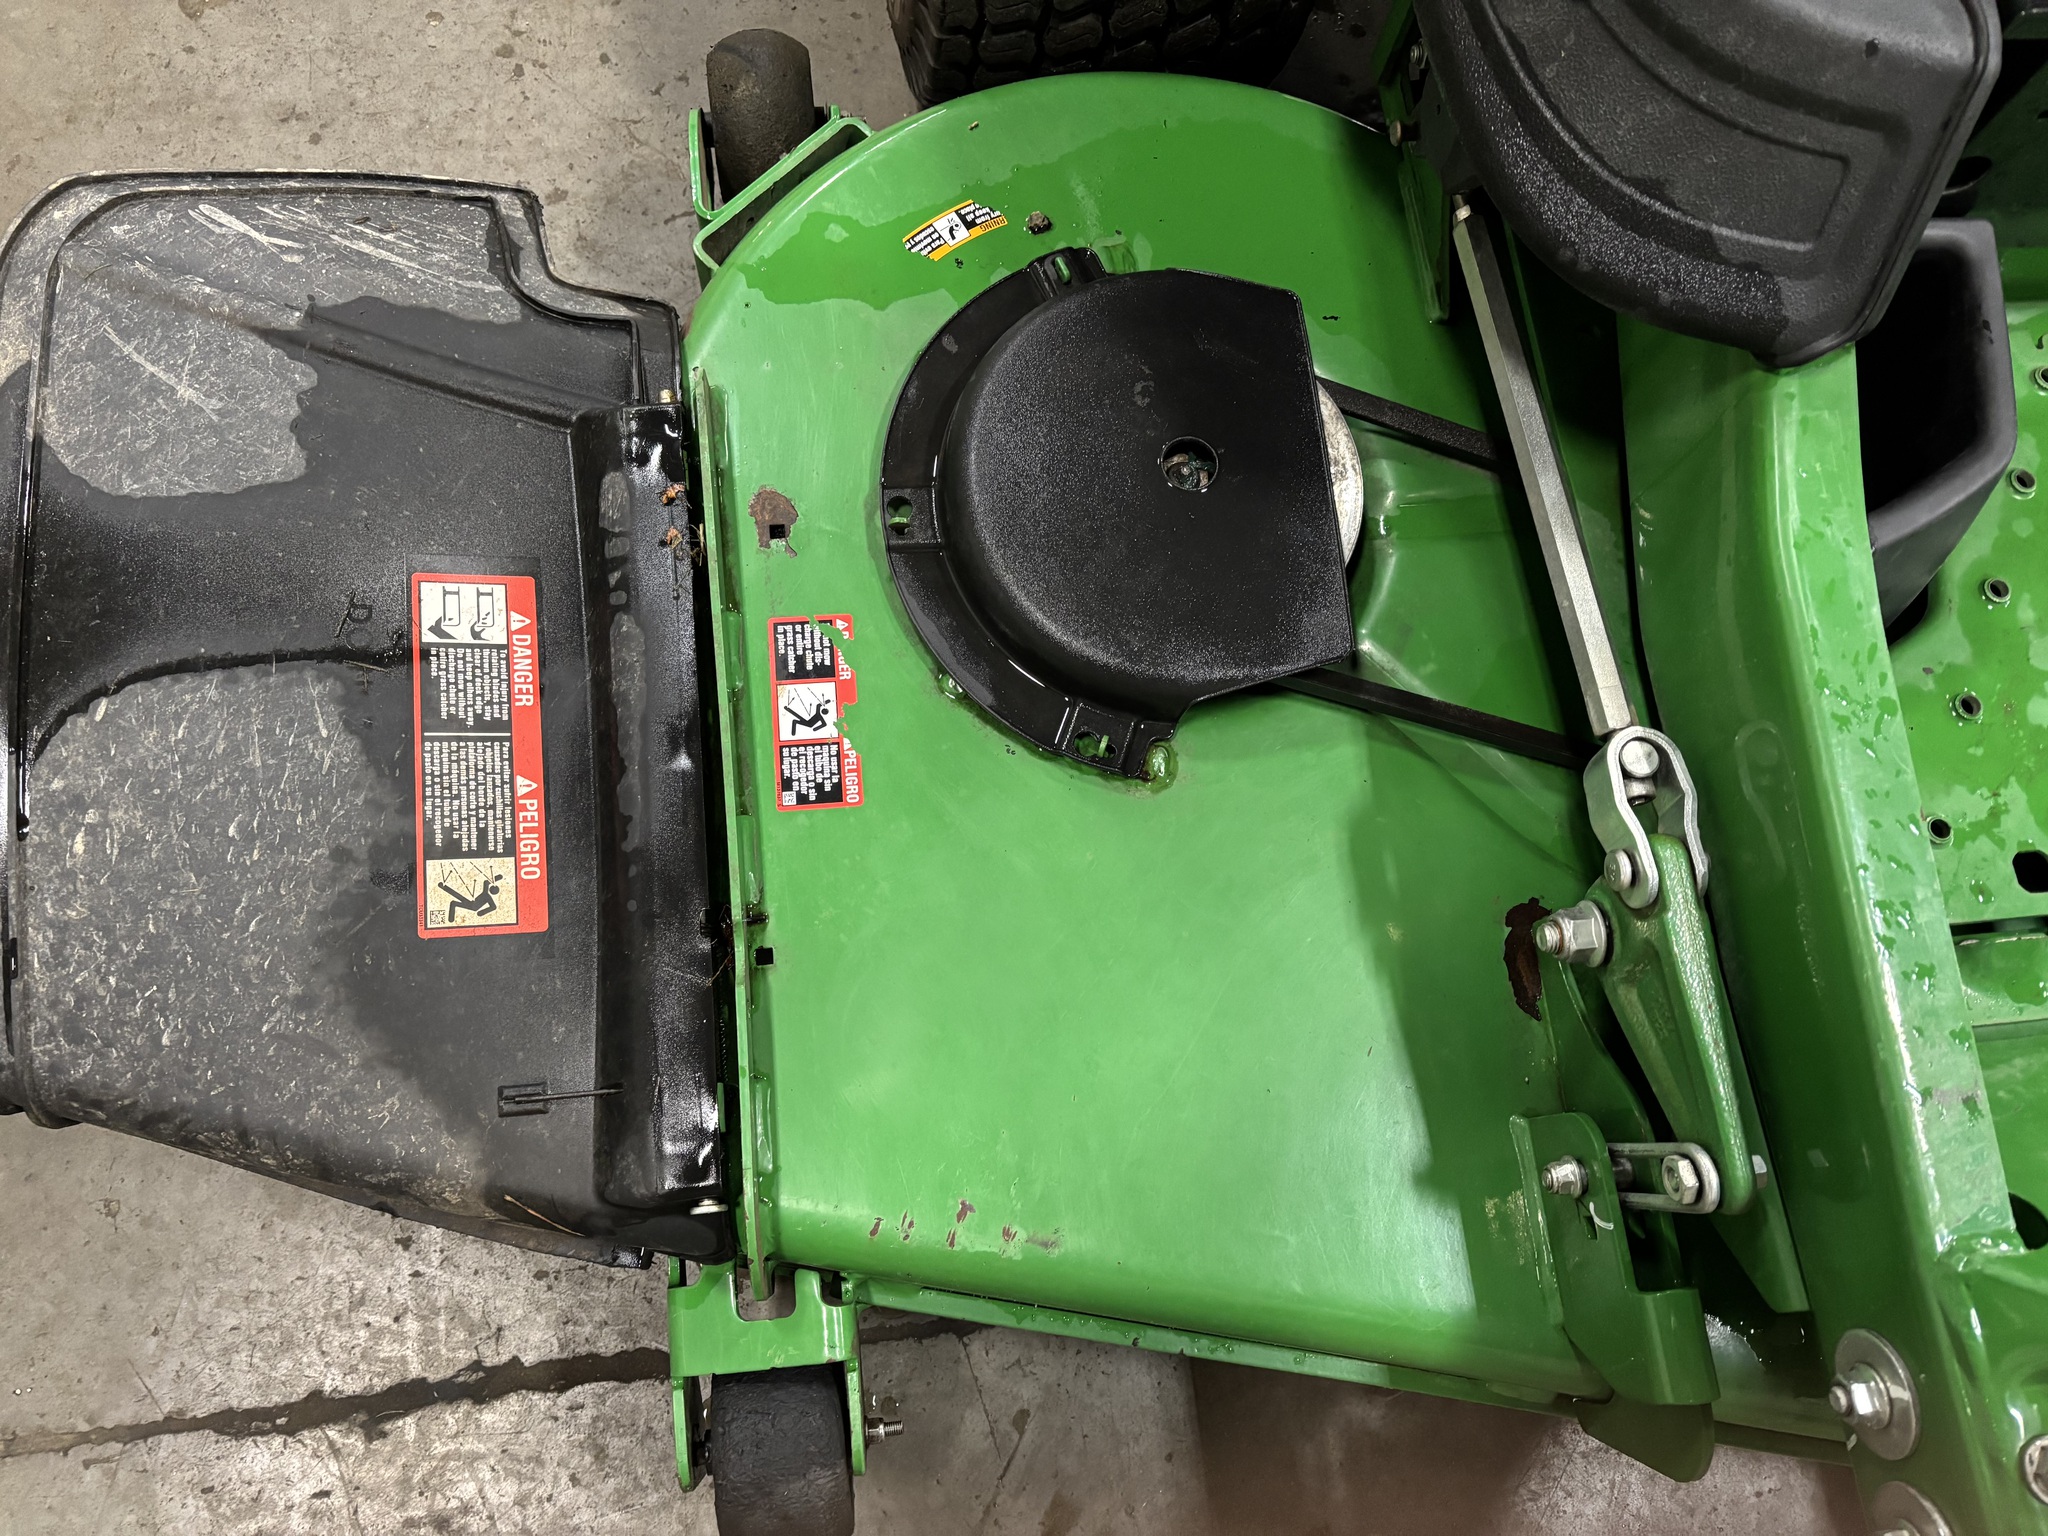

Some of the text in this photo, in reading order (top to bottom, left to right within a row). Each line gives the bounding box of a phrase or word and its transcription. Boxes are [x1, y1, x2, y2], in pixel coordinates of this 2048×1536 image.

[965, 213, 975, 222] all
[979, 216, 1006, 233] RNING
[931, 238, 945, 249] Para
[776, 625, 787, 657] in place.
[785, 624, 797, 674] grass catcher
[795, 624, 805, 655] or entire
[802, 623, 815, 671] charge chute
[429, 657, 439, 679] place.
[474, 649, 482, 667] clear
[512, 634, 534, 706] DANGER
[823, 648, 831, 666] mow
[439, 648, 448, 720] entire grass catcher
[447, 648, 457, 715] discharge chute or
[457, 648, 466, 719] Do not mow without
[465, 648, 474, 728] and keep others away.
[475, 678, 483, 694] deck
[482, 649, 492, 721] thrown objects, stay
[490, 649, 501, 718] rotating blades and
[499, 649, 510, 720] To avoid injury from
[474, 697, 483, 714] edge
[432, 742, 441, 775] descarga
[441, 742, 450, 774] máquina
[450, 742, 458, 751] de
[459, 748, 467, 759] las
[467, 741, 476, 779] plataforma
[484, 748, 493, 773] objetos
[781, 747, 792, 779] su lugar.
[805, 745, 816, 780] descarga
[450, 762, 459, 797] máquina.
[460, 761, 468, 784] demás
[790, 746, 800, 791] de pasto en
[798, 746, 809, 795] el recogedor
[814, 745, 824, 783] el tubo de
[830, 744, 840, 783] No usar la
[843, 750, 860, 803] PELIGRO
[423, 742, 433, 821] de pasto en su lugar.
[434, 784, 442, 796] sin
[443, 789, 450, 797] el
[469, 781, 476, 789] de
[475, 742, 486, 828] alejado del borde de la
[485, 775, 494, 808] lanzados,
[493, 741, 505, 853] causadas por cuchillas giratorias
[502, 742, 513, 838] Para evitar sufrir lesiones
[808, 788, 817, 801] sin
[824, 779, 833, 792] sin
[434, 798, 442, 806] el
[443, 799, 451, 815] tubo
[452, 800, 460, 810] No
[459, 786, 468, 819] personas
[469, 791, 477, 809] corte
[433, 808, 443, 847] recogedor
[444, 818, 451, 827] de
[453, 831, 460, 839] la
[460, 820, 470, 852] alejadas
[470, 817, 478, 850] mantener
[487, 810, 495, 851] mantenerse
[518, 799, 540, 880] PELIGRO
